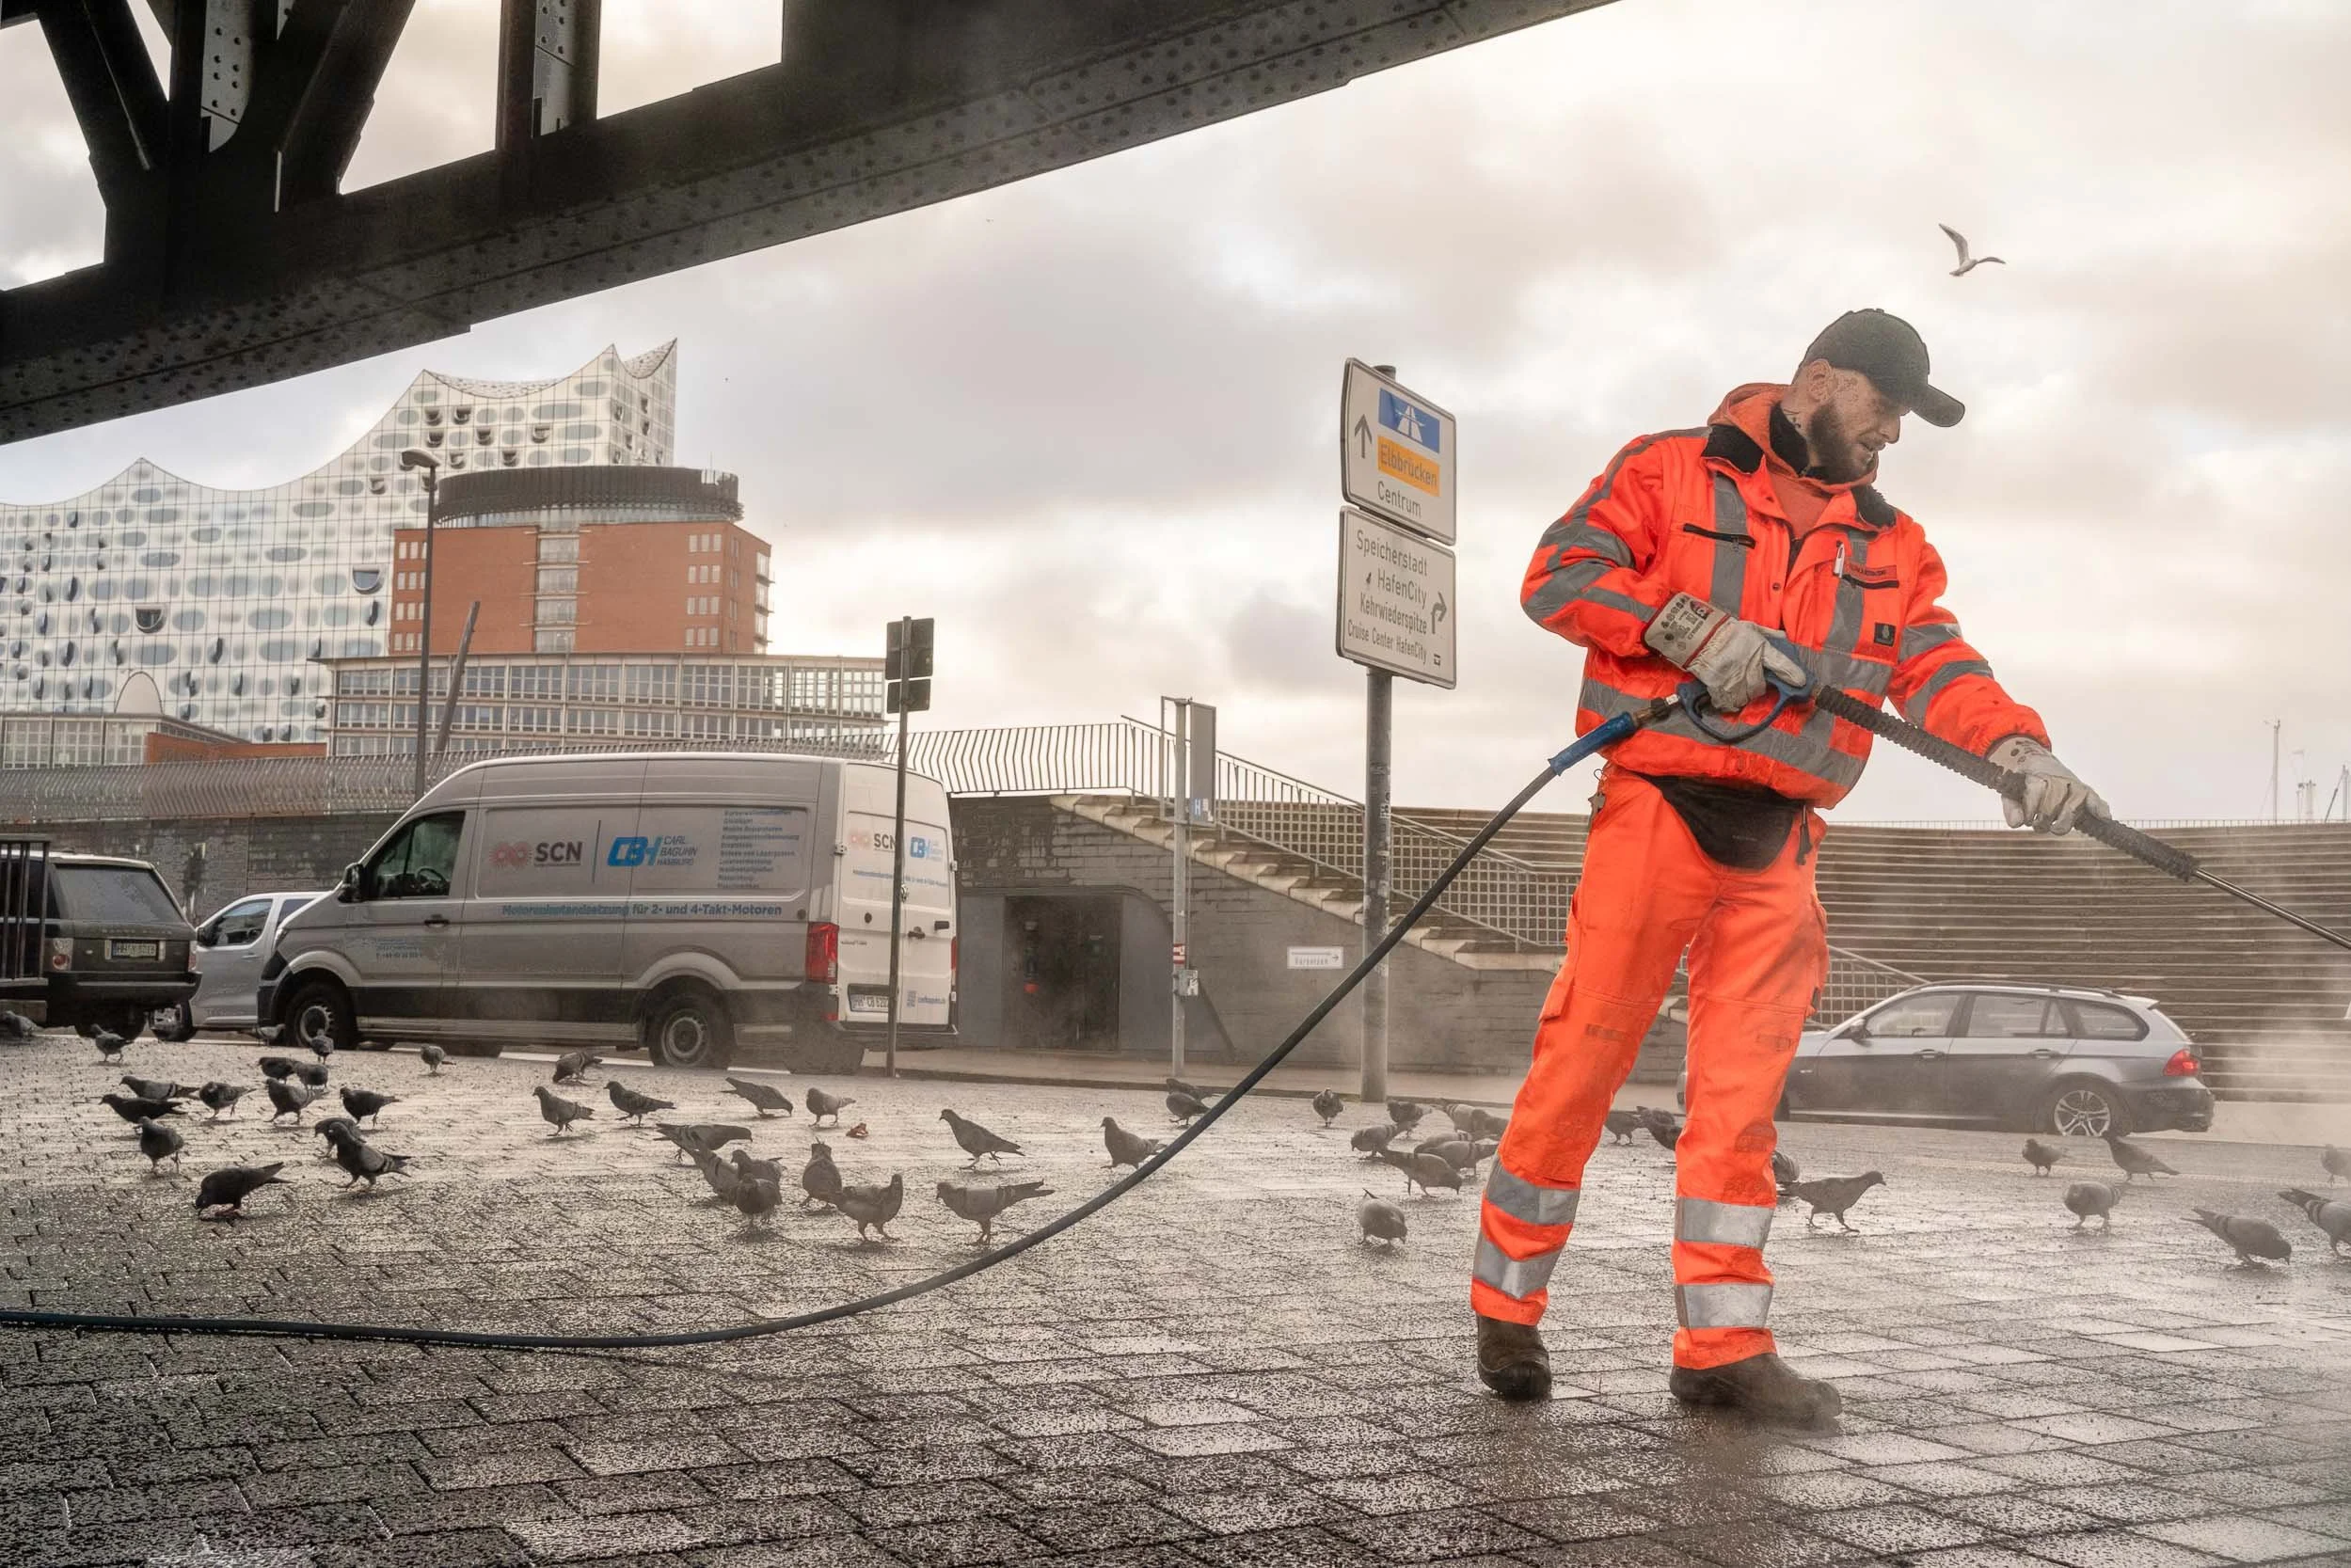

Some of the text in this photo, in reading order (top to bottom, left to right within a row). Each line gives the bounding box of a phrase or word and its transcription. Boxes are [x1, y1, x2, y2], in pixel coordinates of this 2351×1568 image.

[1377, 481, 1422, 516] Centrum
[1357, 530, 1427, 576] Speicherstadt
[1377, 567, 1427, 610] HafenCity
[1359, 592, 1427, 636] Kehrwiederspitze
[1348, 619, 1369, 641] Cruise
[1372, 627, 1393, 651] Center
[535, 842, 583, 862] SCN
[660, 847, 698, 857] BAGUHN
[663, 835, 686, 845] CARL
[632, 903, 649, 915] für
[651, 903, 662, 915] 2-
[665, 903, 688, 915] und
[691, 903, 783, 915] 4-Takt-Motoren
